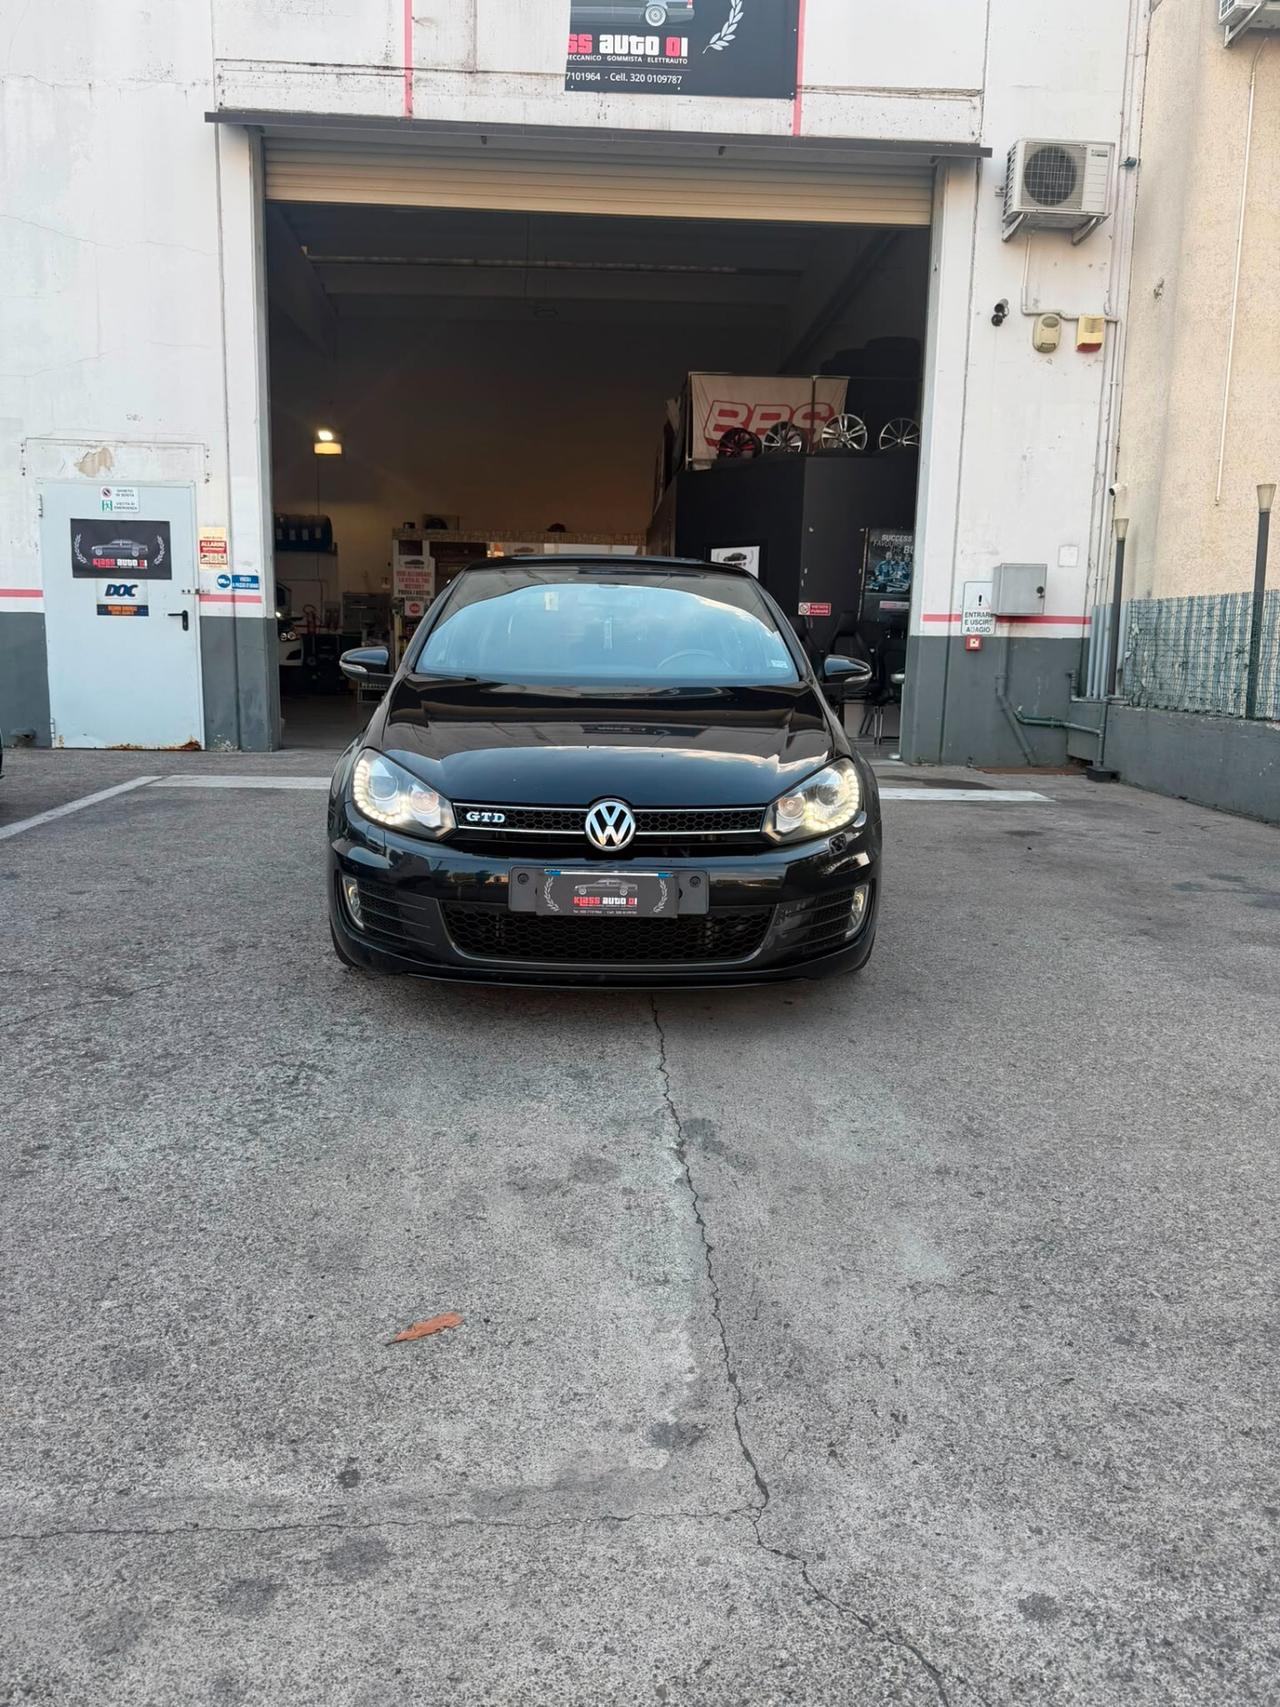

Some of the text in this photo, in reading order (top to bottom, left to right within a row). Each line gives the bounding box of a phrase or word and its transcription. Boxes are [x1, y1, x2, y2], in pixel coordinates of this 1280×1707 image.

[599, 34, 660, 55] auto
[606, 55, 643, 63] GOMMISTA
[647, 56, 688, 65] ELETTRAUTO
[610, 72, 628, 82] Cell.
[630, 73, 646, 82] 320
[647, 73, 683, 84] 0109787
[105, 583, 139, 597] DOC
[466, 811, 505, 823] GTD
